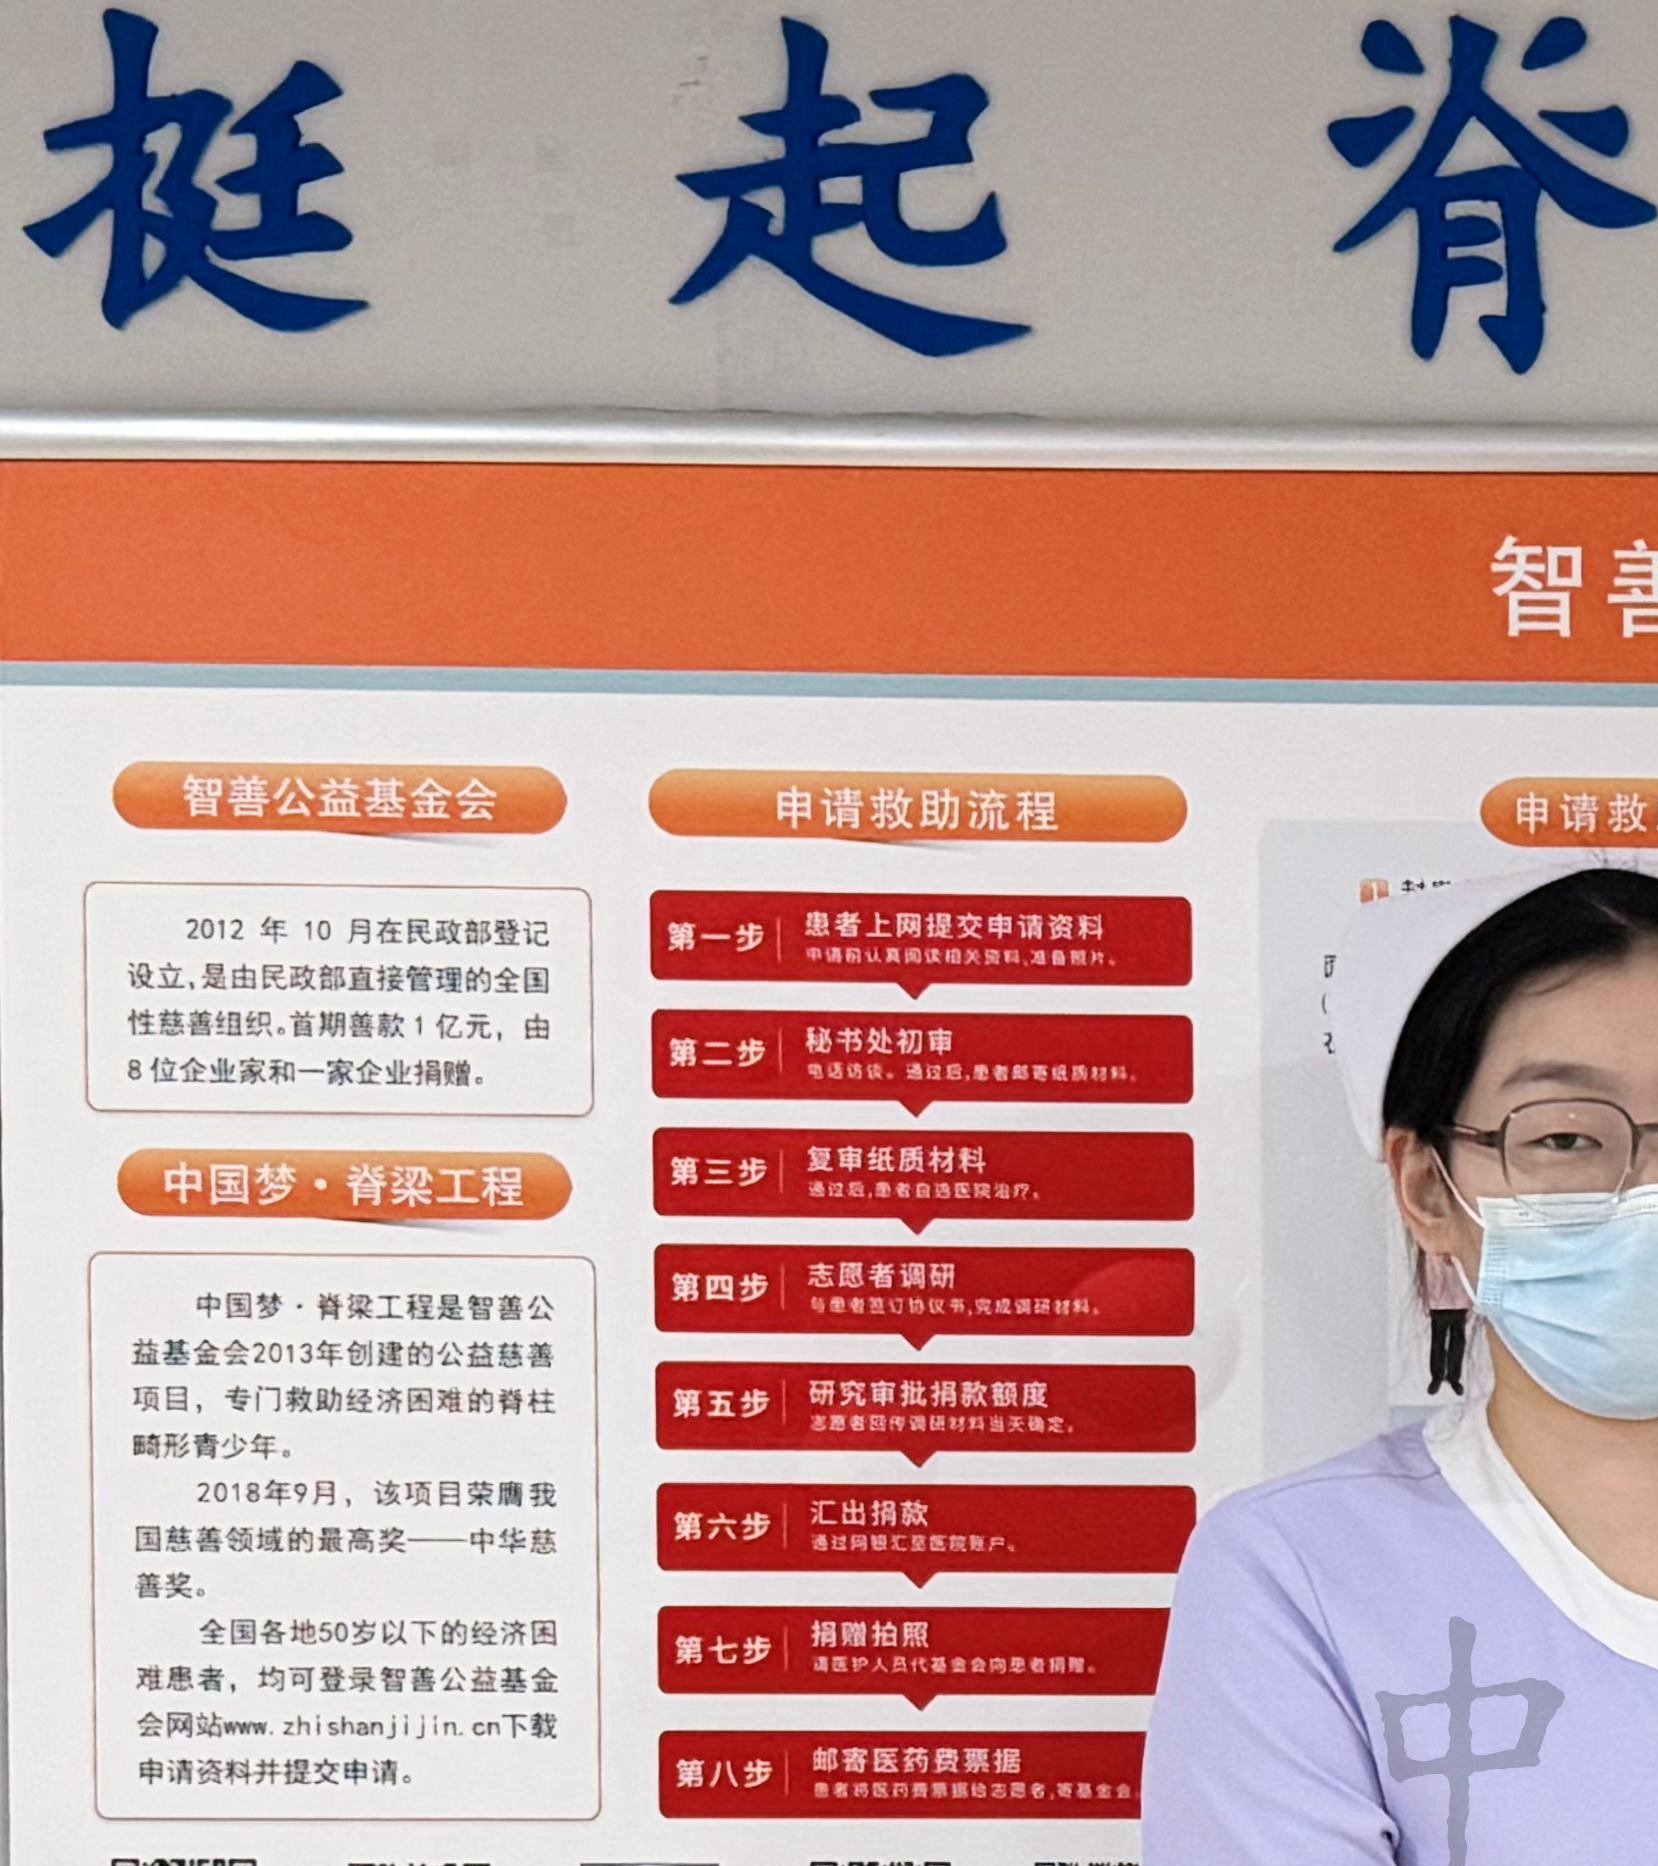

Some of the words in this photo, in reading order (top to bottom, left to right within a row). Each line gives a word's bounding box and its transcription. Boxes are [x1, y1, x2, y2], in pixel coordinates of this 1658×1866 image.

[183, 774, 498, 821] 智善公益基金会
[776, 786, 1059, 832] 申请救助流程
[667, 921, 765, 952] 第一步
[805, 911, 1104, 941] 患者上网提交申请资料
[669, 1037, 766, 1067] 第二步
[806, 1026, 954, 1055] 秘书处初审
[671, 1156, 767, 1186] 第三步
[807, 1145, 987, 1174] 复审纸质材料
[163, 1160, 524, 1207] 中国梦·脊梁工程
[672, 1273, 769, 1303] 第四步
[808, 1262, 956, 1290] 志愿者调研
[131, 1339, 554, 1369] 益基金会2013年创建的公益慈善
[673, 1388, 770, 1418] 第五步
[809, 1380, 1050, 1409] 研究审批捐款额度
[132, 1432, 293, 1460] 畸形青少年。
[674, 1512, 771, 1542] 第六步
[810, 1499, 929, 1527] 汇出捐款
[135, 1572, 207, 1599] 善奖。
[199, 1619, 558, 1647] 全国各地50岁以下的经济困
[812, 1621, 929, 1649] 捐赠拍照
[675, 1635, 772, 1665] 第七步
[139, 1758, 413, 1786] 申请资料并提交申请。
[676, 1758, 773, 1789] 第八步
[813, 1748, 1022, 1775] 邮寄医药费票据
